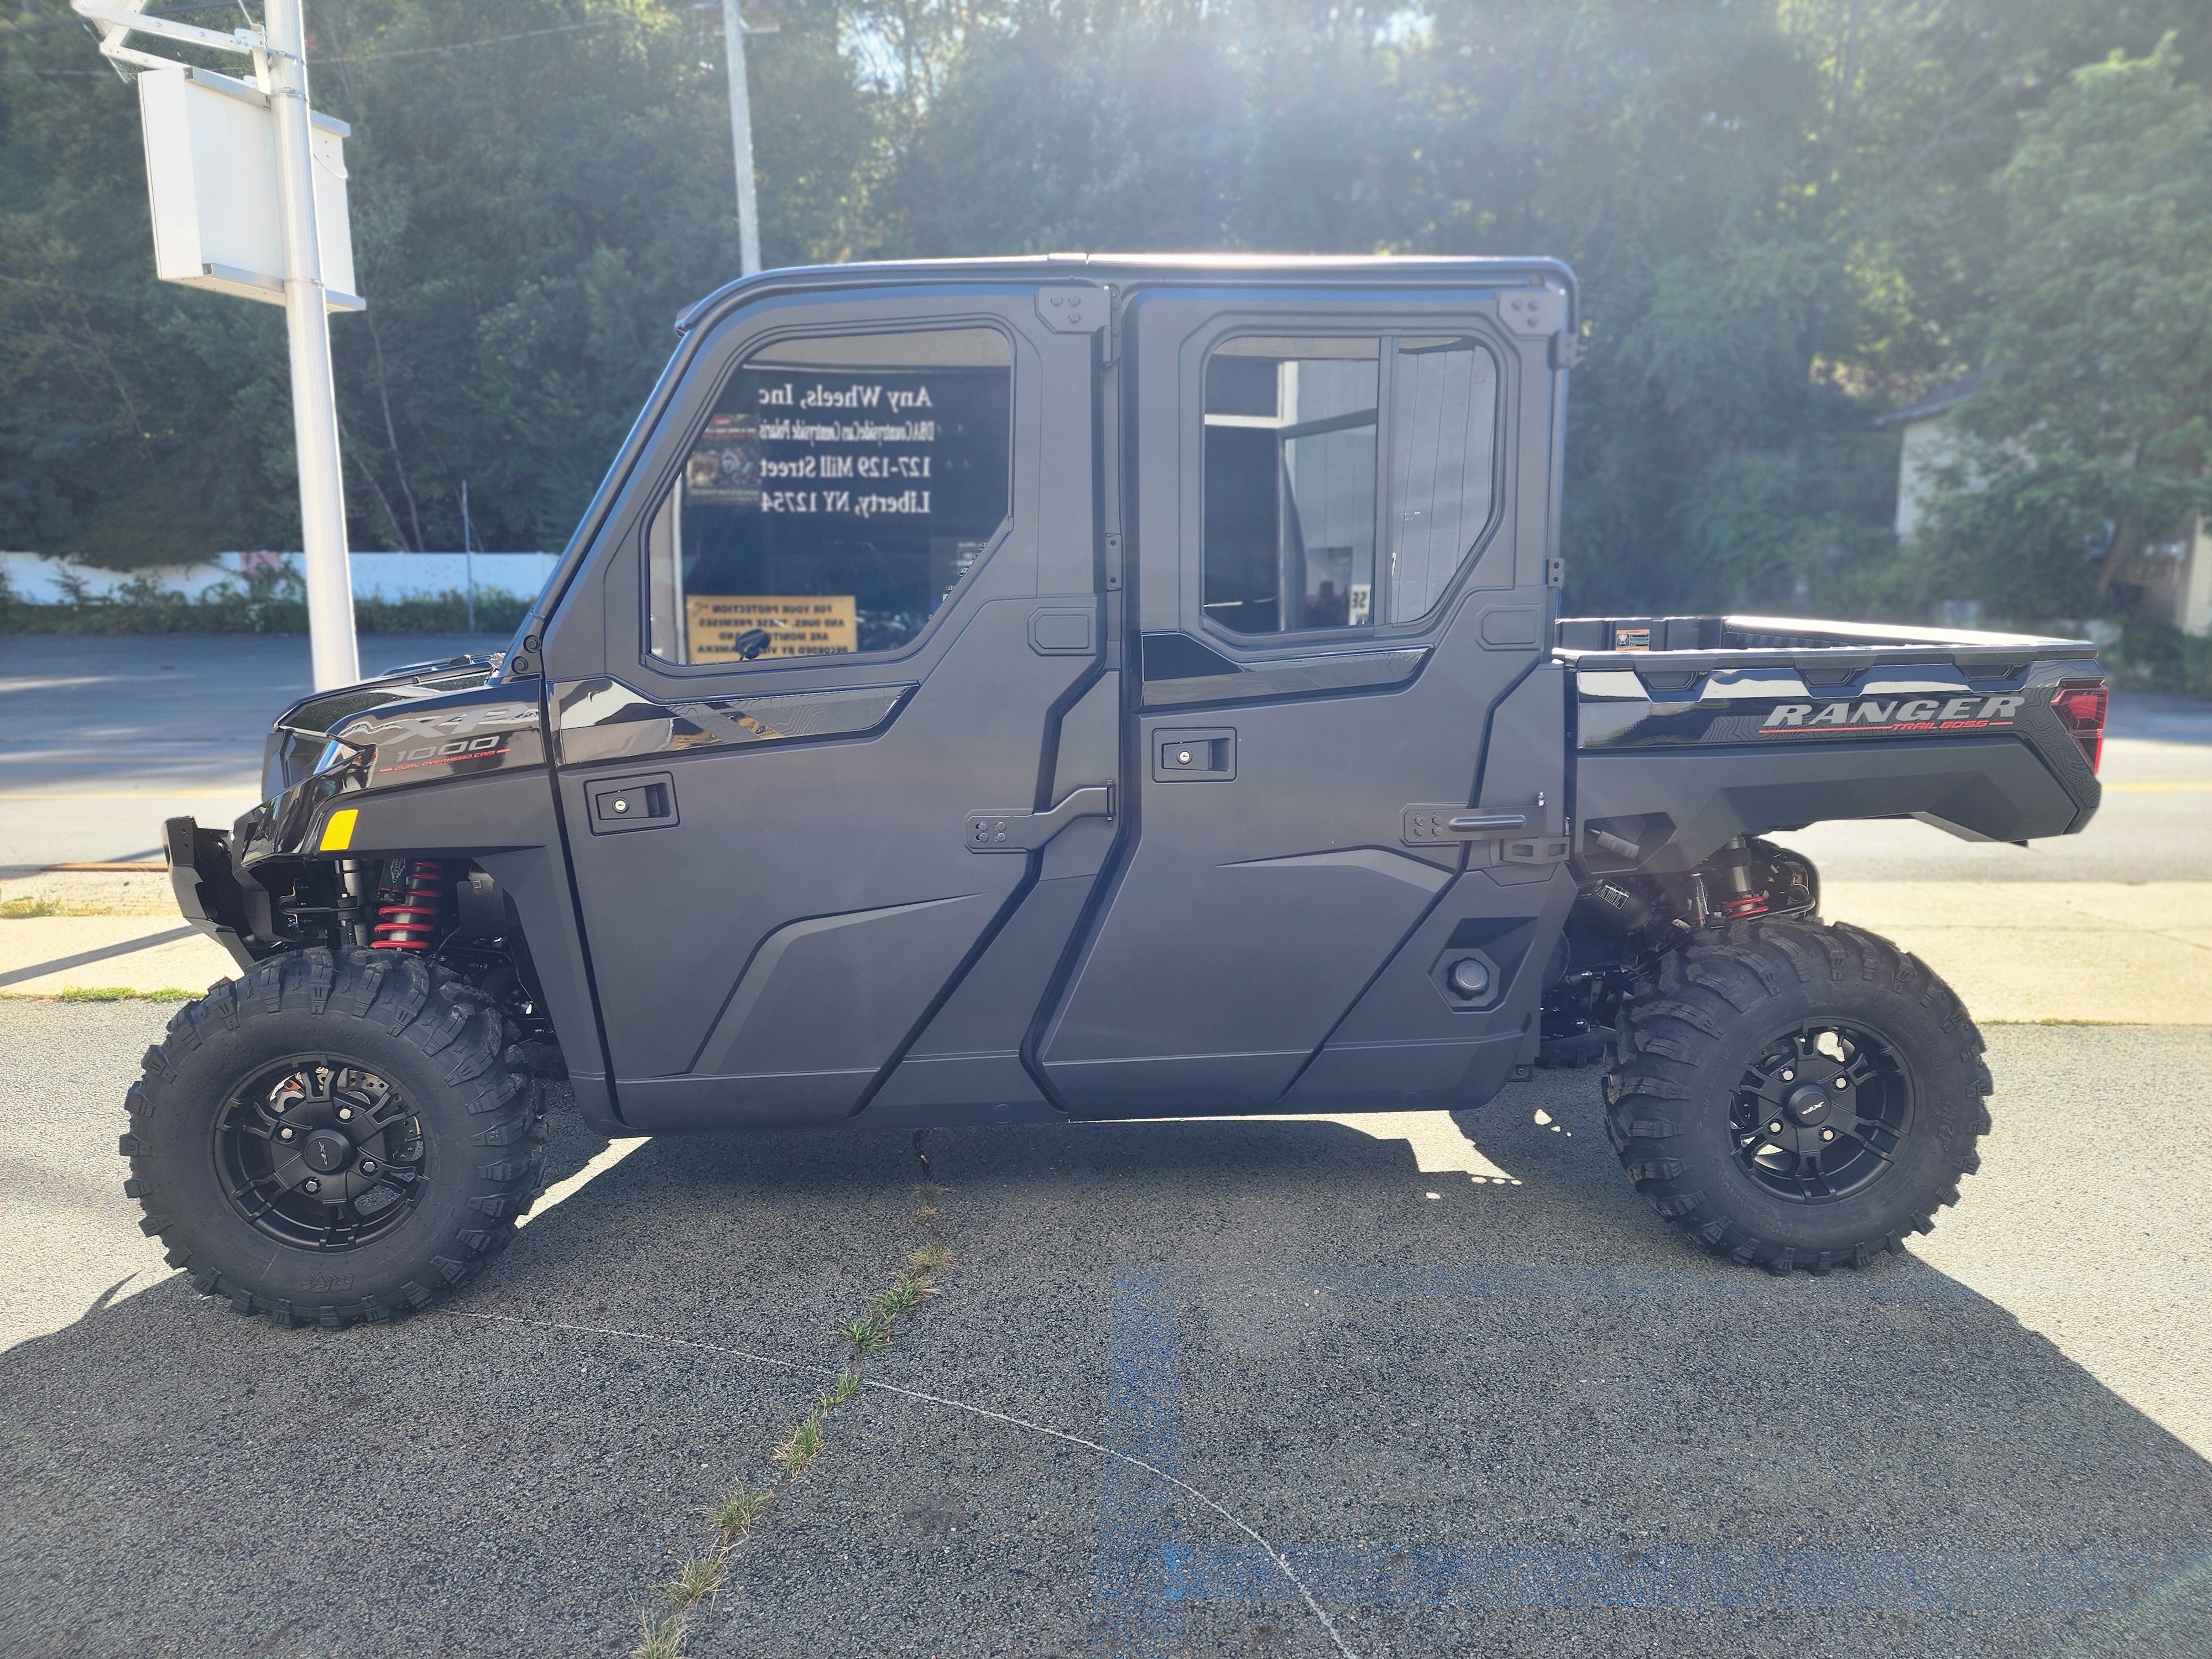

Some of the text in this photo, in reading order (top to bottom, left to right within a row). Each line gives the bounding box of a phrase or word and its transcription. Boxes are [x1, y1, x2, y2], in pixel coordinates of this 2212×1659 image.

[377, 703, 529, 747] XP
[1763, 697, 2025, 727] RANGER
[1891, 720, 1988, 731] TRAIL BOSS
[394, 750, 496, 771] DUAL OVERHEAD CAM
[396, 736, 500, 763] 1000
